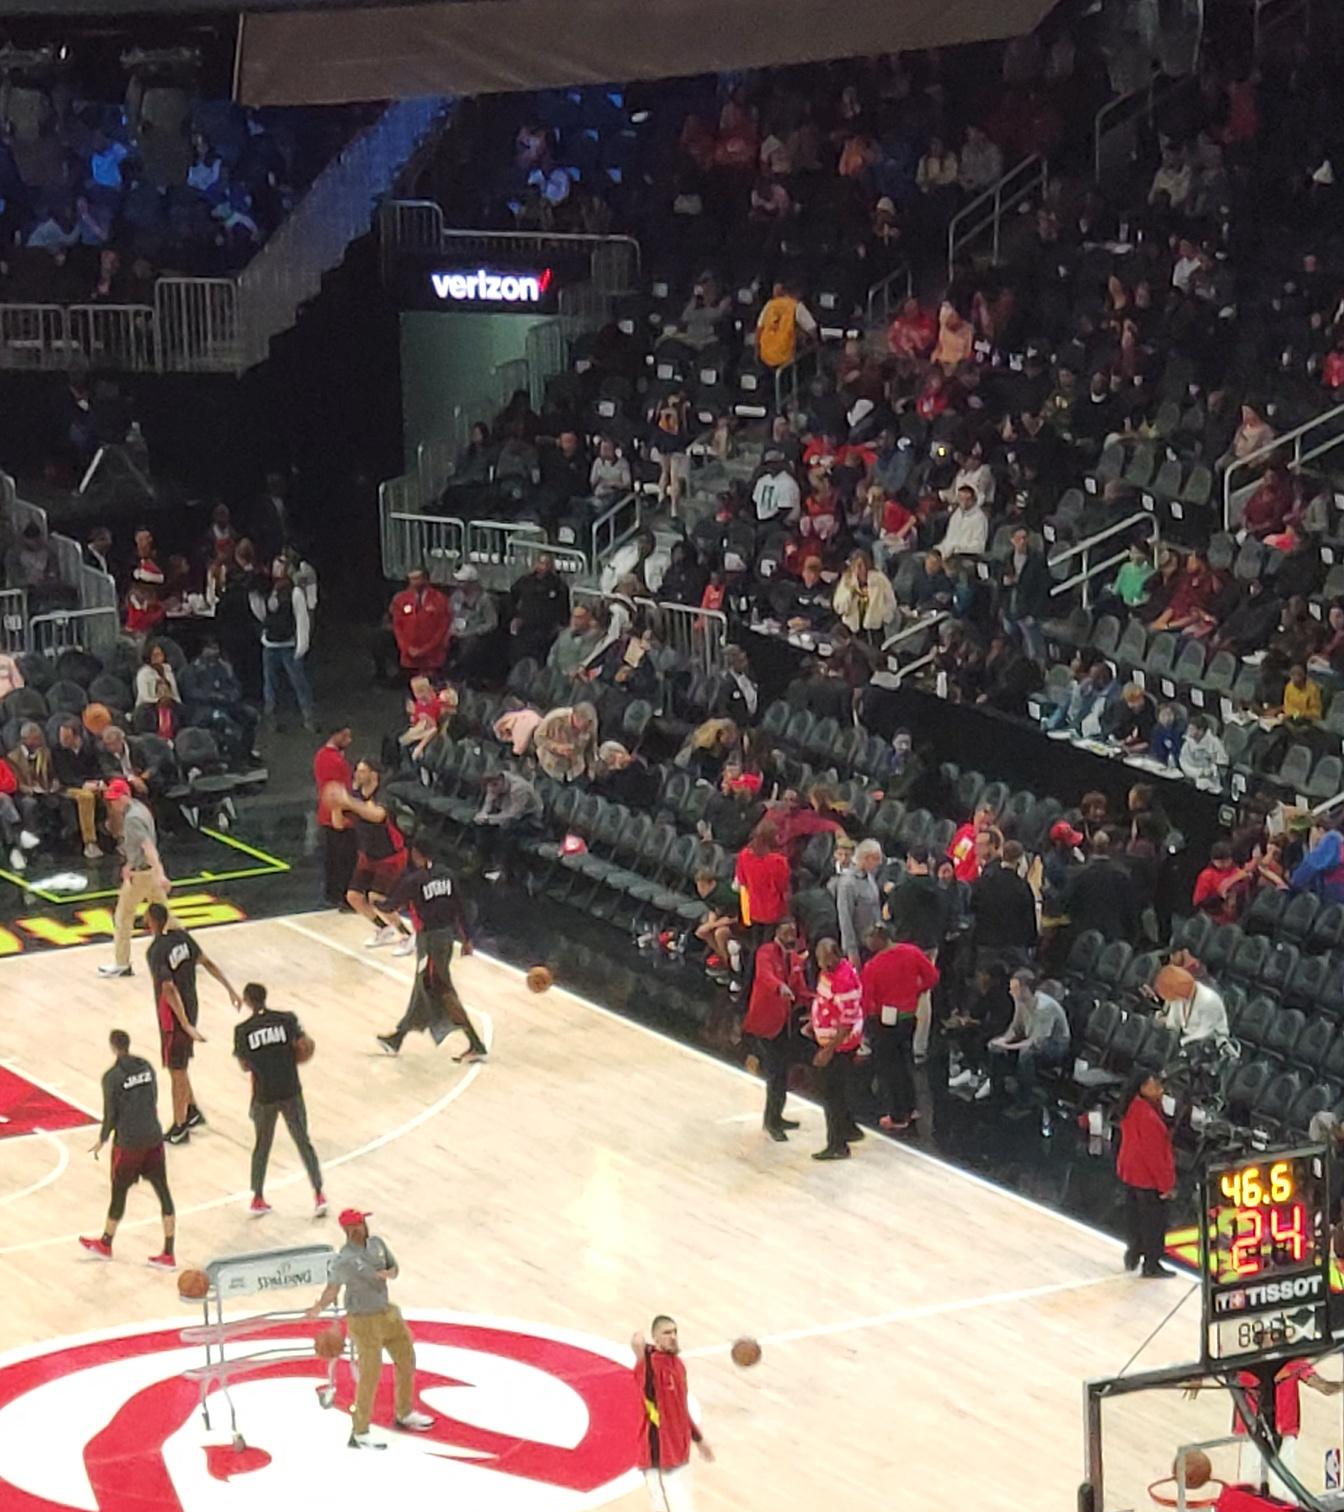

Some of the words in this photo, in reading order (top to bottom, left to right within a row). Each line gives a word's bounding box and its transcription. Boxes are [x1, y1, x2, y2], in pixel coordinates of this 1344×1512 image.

[431, 269, 540, 301] verizon
[422, 877, 452, 900] UTAH
[247, 1023, 287, 1050] UTAH
[1220, 1162, 1293, 1207] 46.6
[1230, 1205, 1305, 1274] 24
[1246, 1274, 1323, 1306] TISSOT
